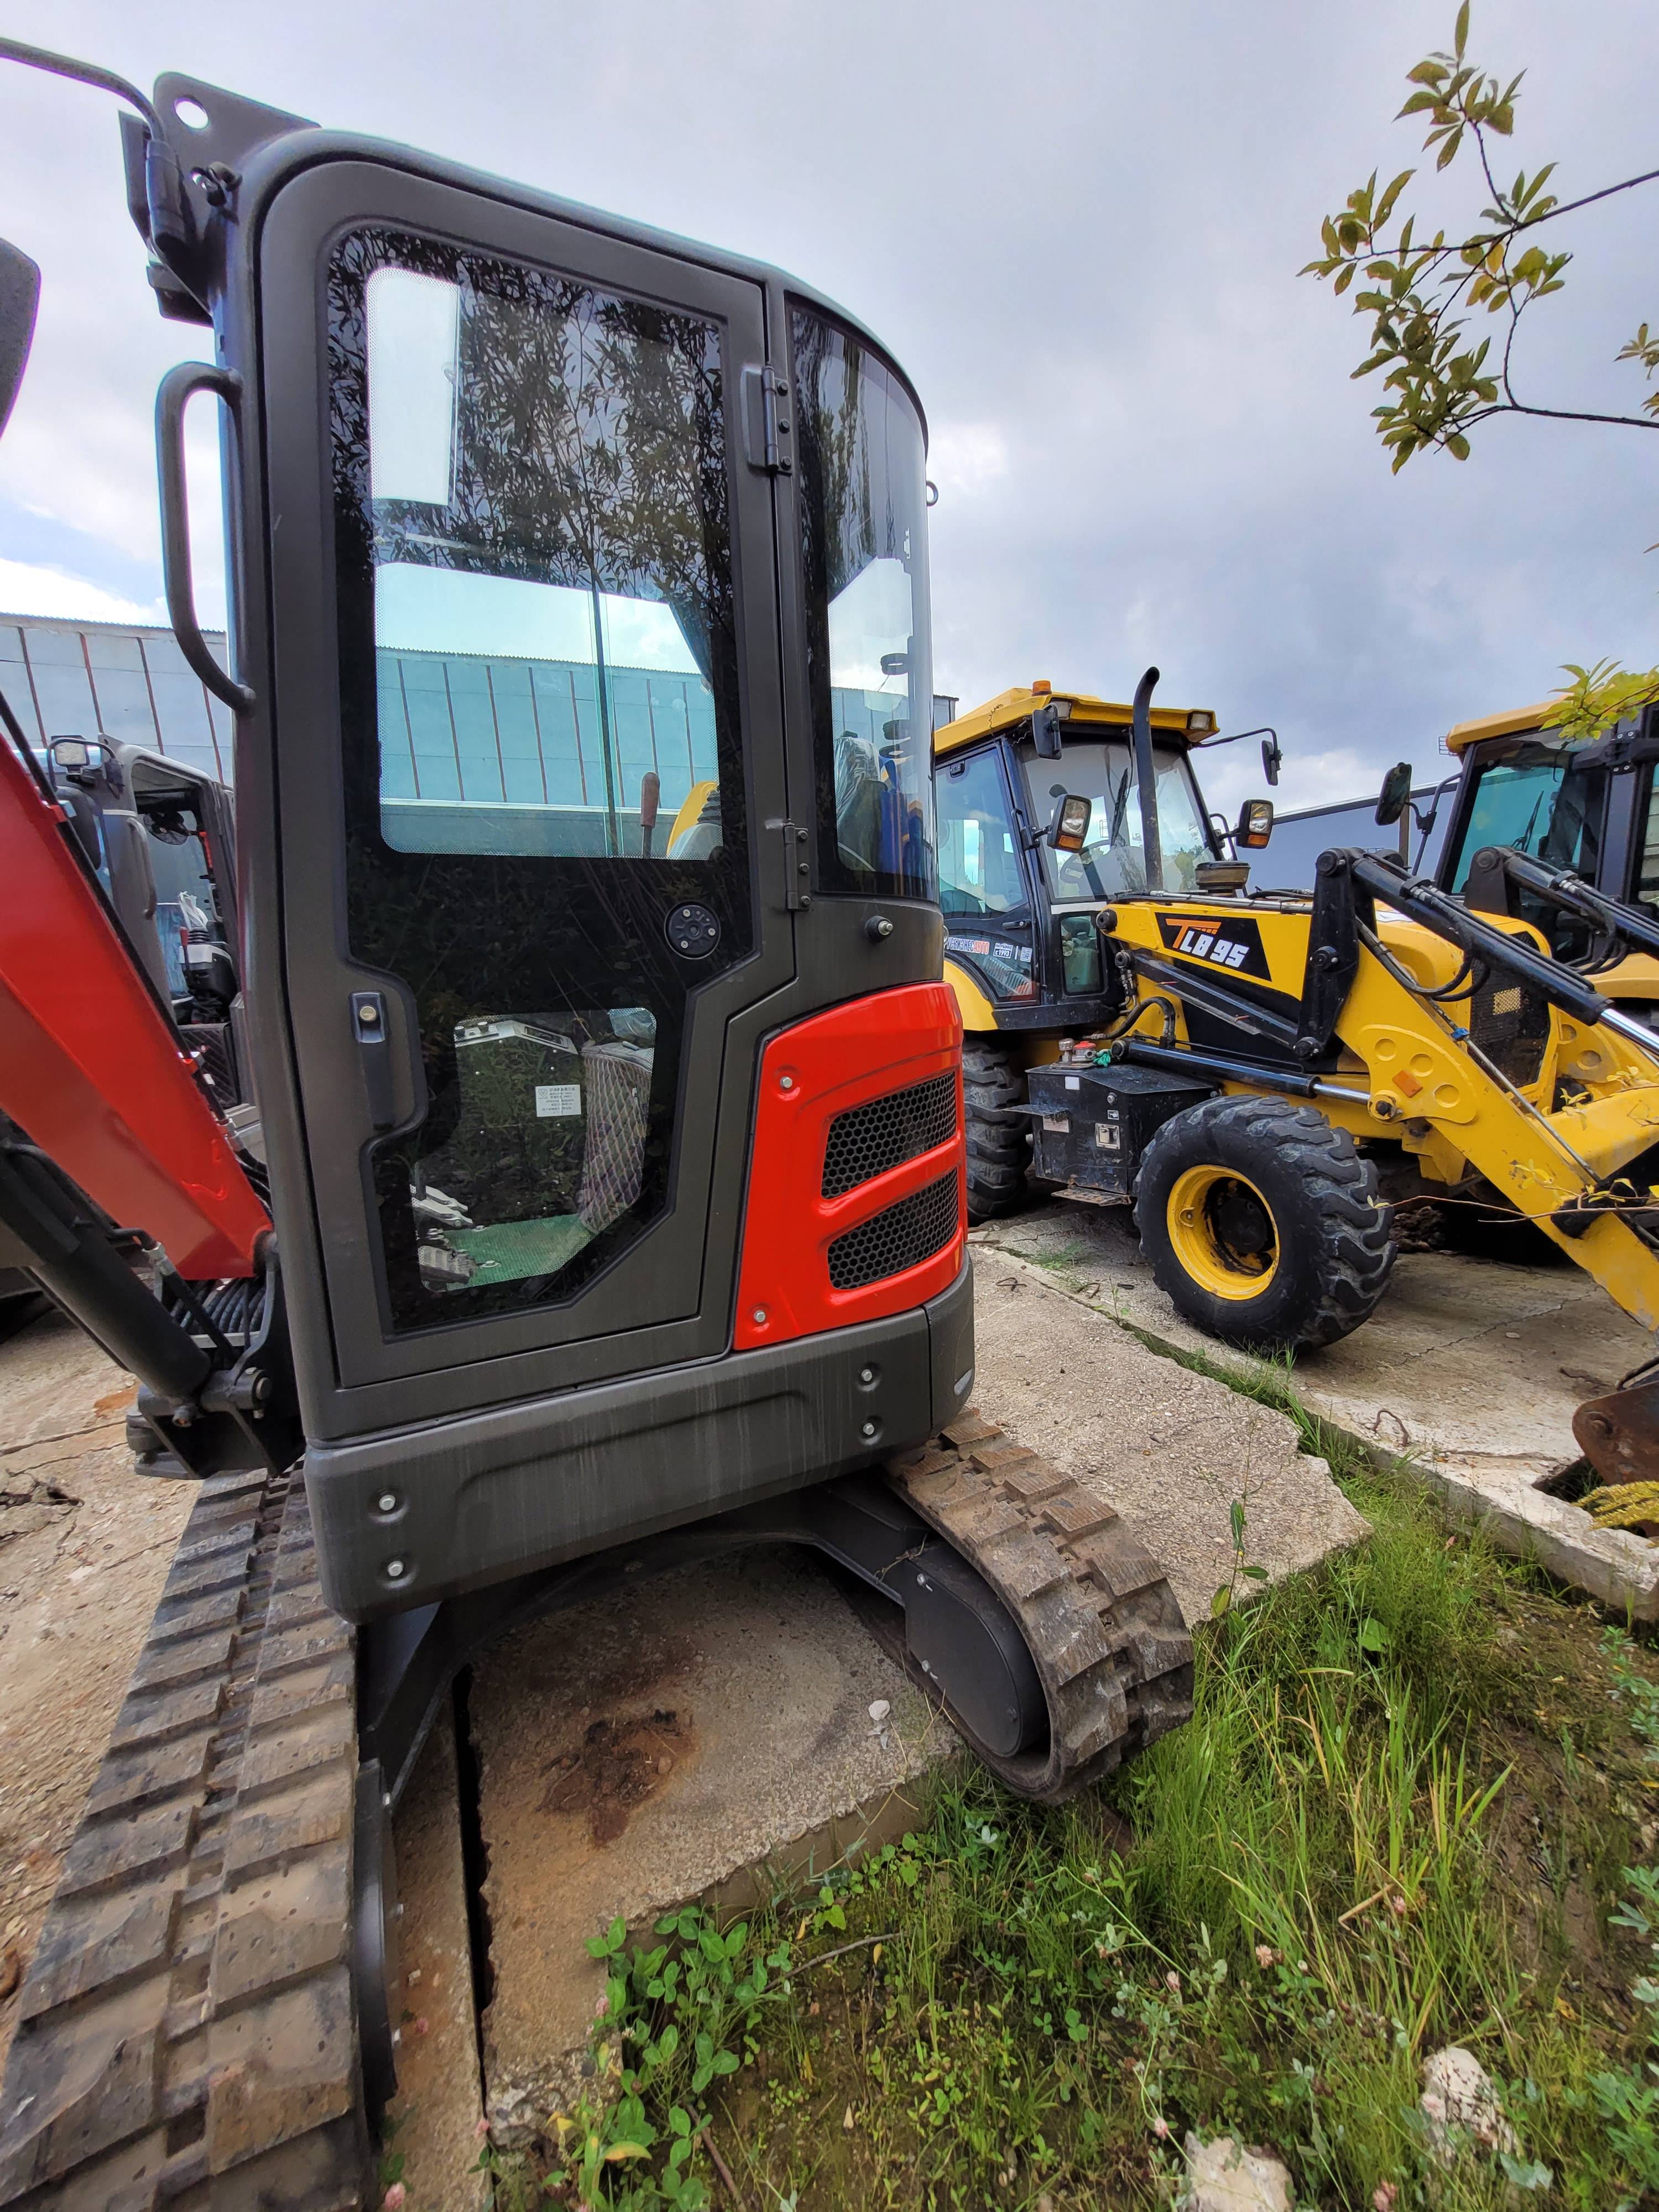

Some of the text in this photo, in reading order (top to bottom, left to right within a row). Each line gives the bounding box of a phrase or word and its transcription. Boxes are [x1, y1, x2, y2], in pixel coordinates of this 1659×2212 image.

[946, 937, 989, 954] УСБИЗНЕСАВТО
[1165, 918, 1249, 968] TLB 95
